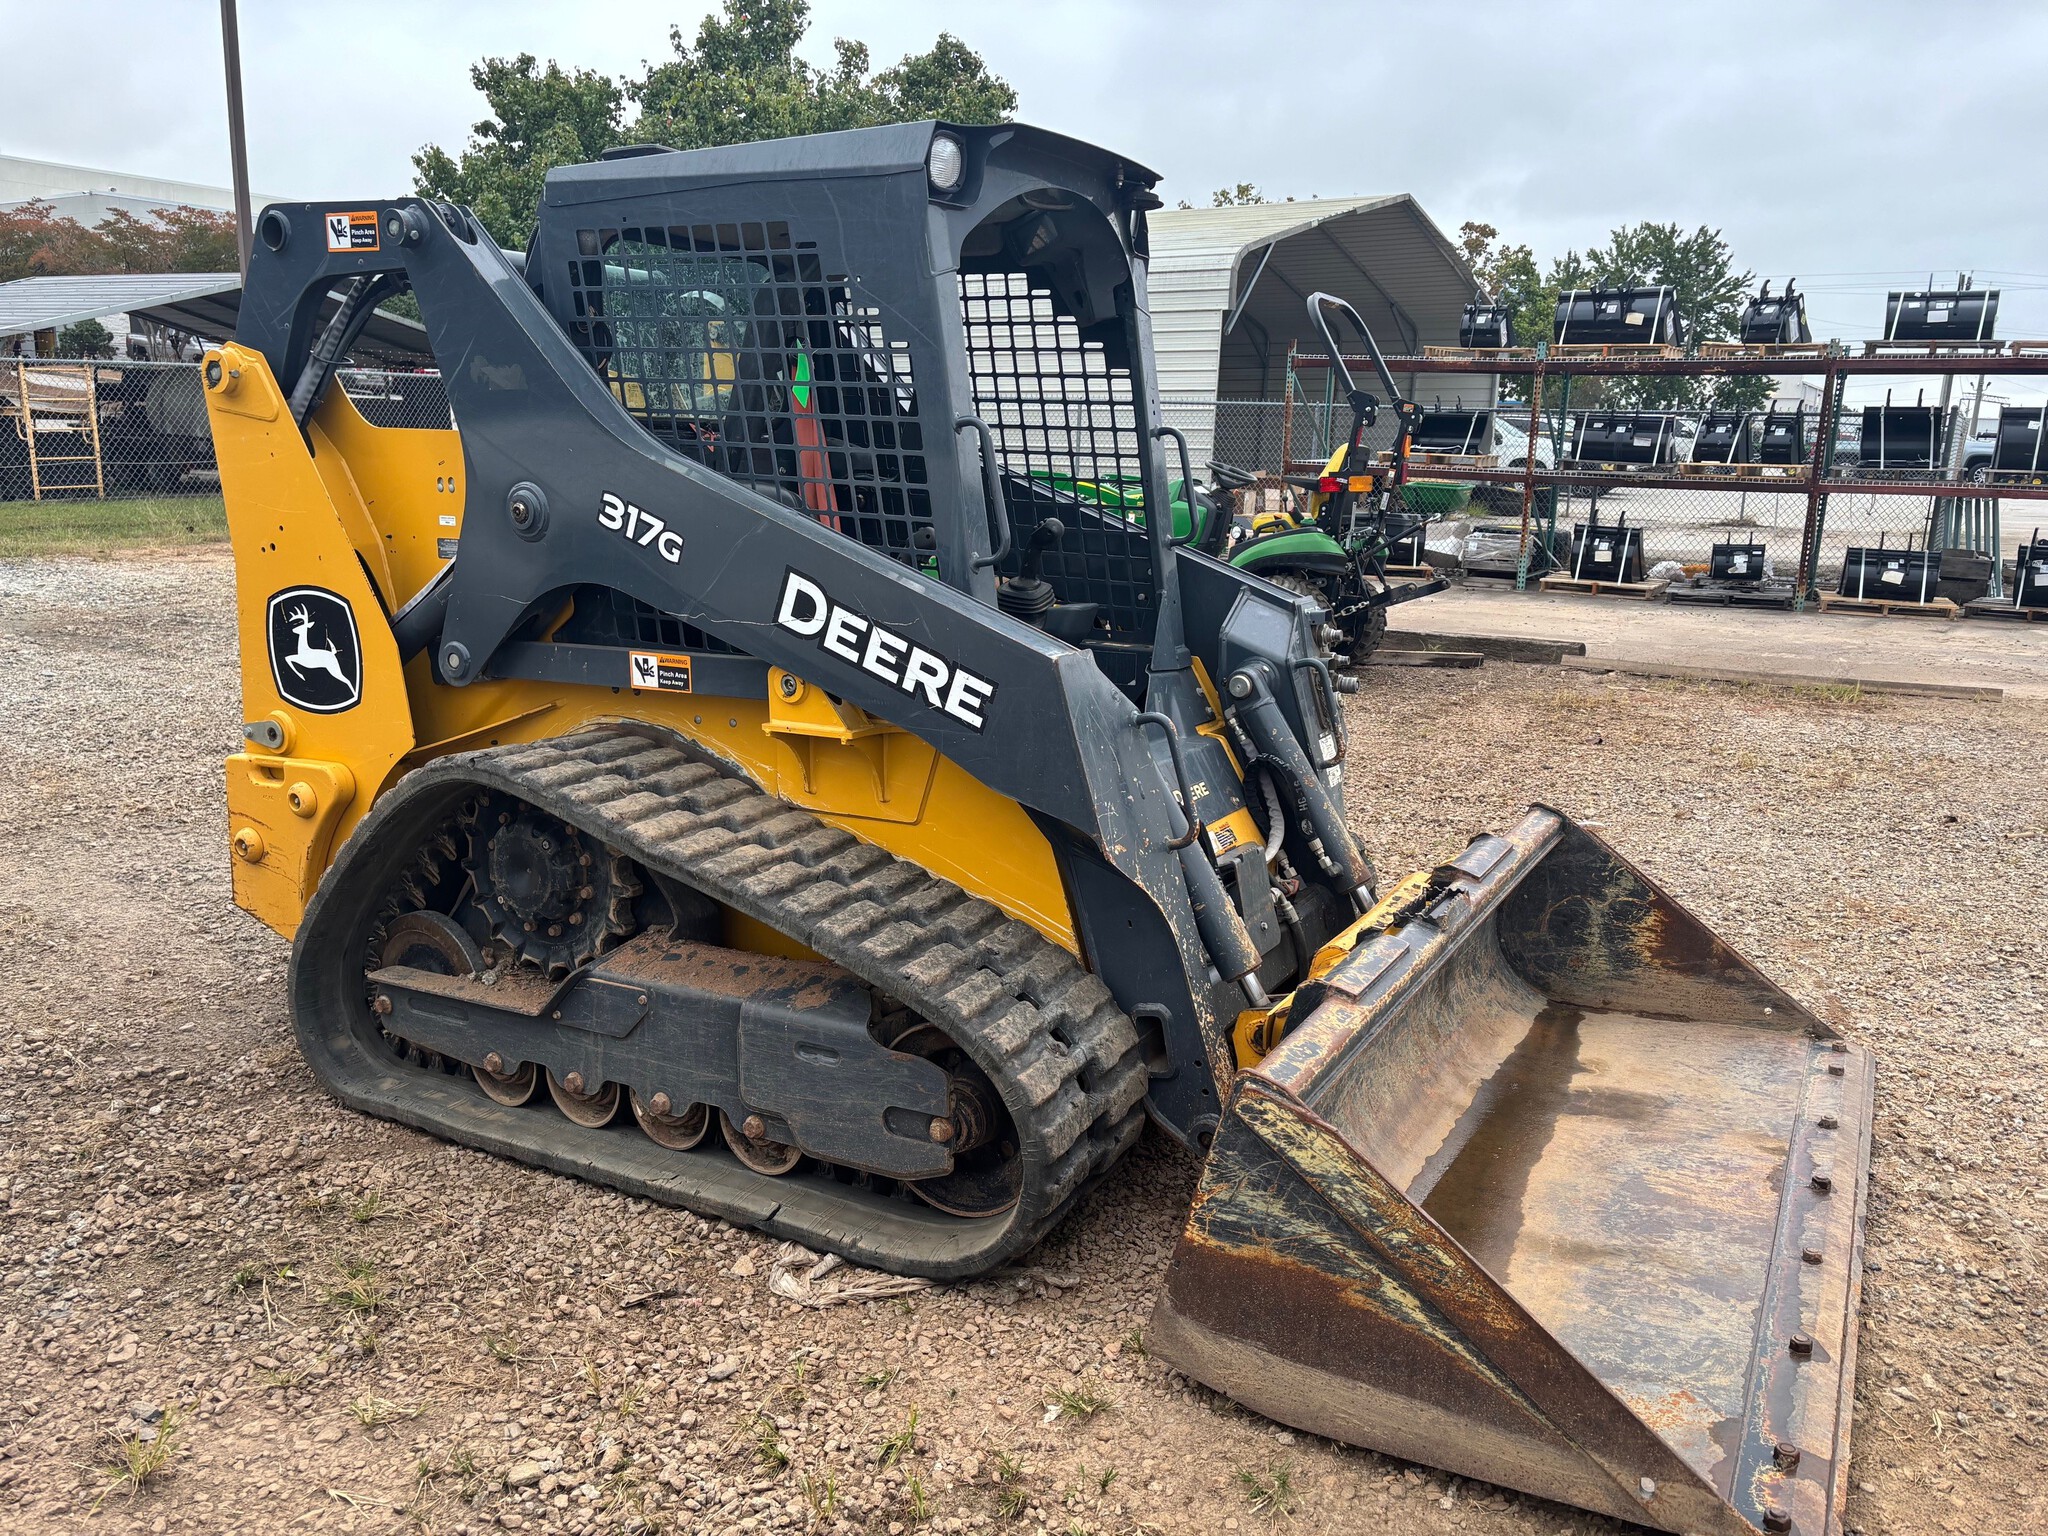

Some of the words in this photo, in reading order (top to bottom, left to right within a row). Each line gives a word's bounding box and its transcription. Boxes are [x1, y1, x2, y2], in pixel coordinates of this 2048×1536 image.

[598, 492, 684, 563] 317G
[660, 670, 674, 678] Pinch
[778, 572, 993, 729] DEERE
[1172, 781, 1210, 806] DERE
